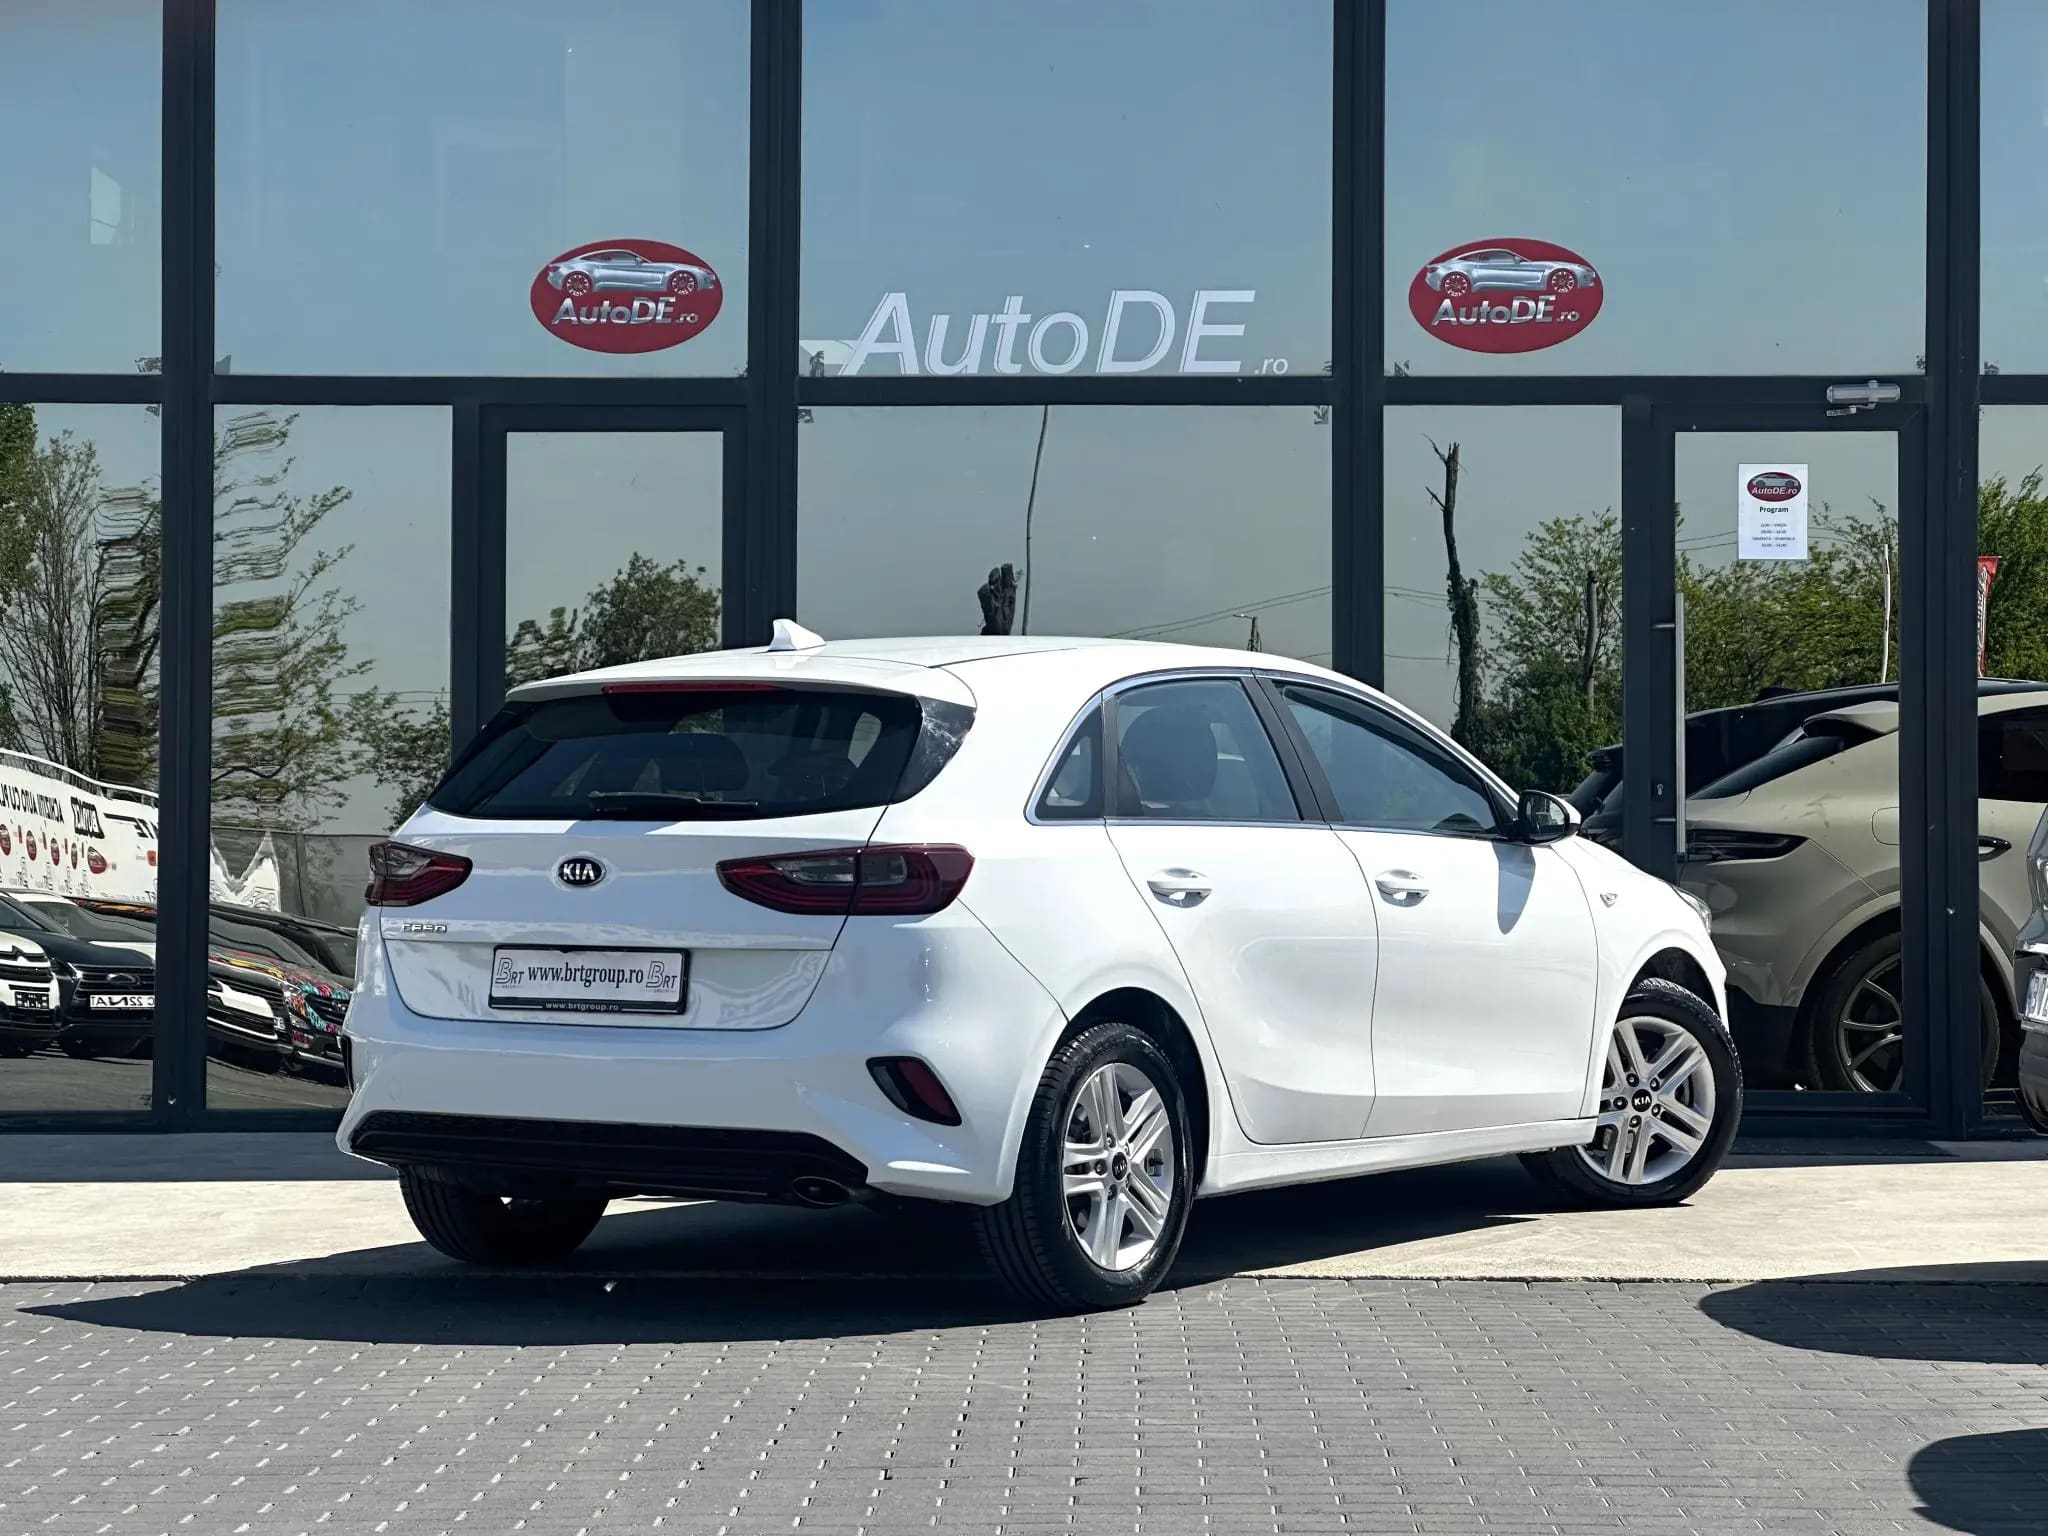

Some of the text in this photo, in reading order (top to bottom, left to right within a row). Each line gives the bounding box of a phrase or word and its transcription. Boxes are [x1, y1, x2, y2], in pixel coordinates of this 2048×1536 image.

[562, 863, 595, 881] KIA
[528, 961, 644, 989] www.brtgroup.ro
[545, 1001, 620, 1012] www.brtgroup.ro
[1634, 1096, 1651, 1105] KIA
